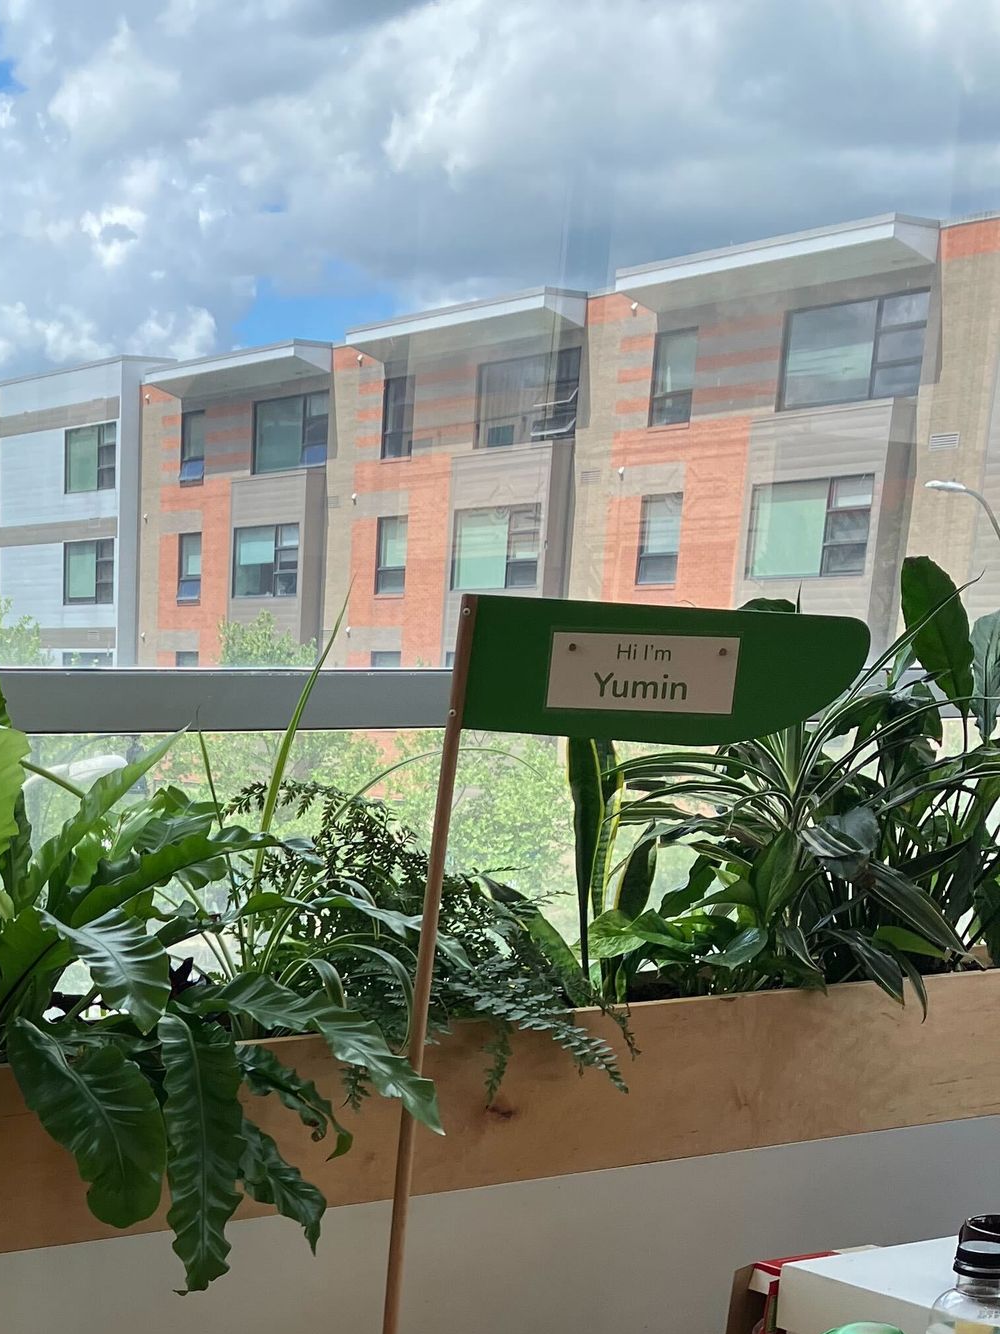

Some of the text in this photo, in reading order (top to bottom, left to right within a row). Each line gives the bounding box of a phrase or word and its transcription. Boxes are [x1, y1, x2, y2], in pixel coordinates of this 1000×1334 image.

[616, 643, 672, 662] Hi I'm
[594, 671, 688, 700] Yumin
